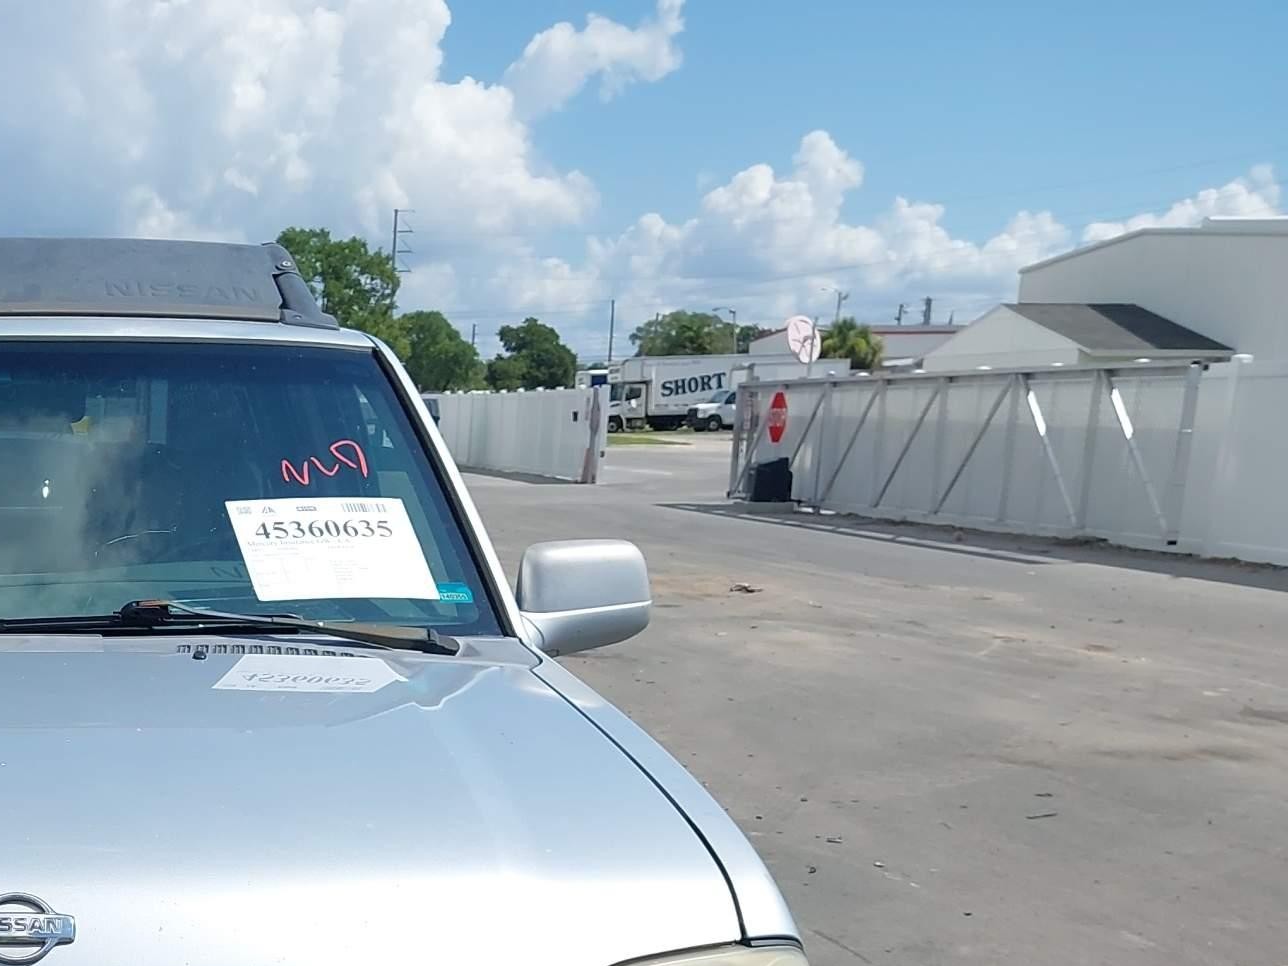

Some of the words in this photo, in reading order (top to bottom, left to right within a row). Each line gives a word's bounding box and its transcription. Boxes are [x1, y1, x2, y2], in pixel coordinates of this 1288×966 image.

[104, 279, 259, 301] NISSAN
[660, 372, 727, 397] SHORT
[255, 519, 393, 540] 45360635
